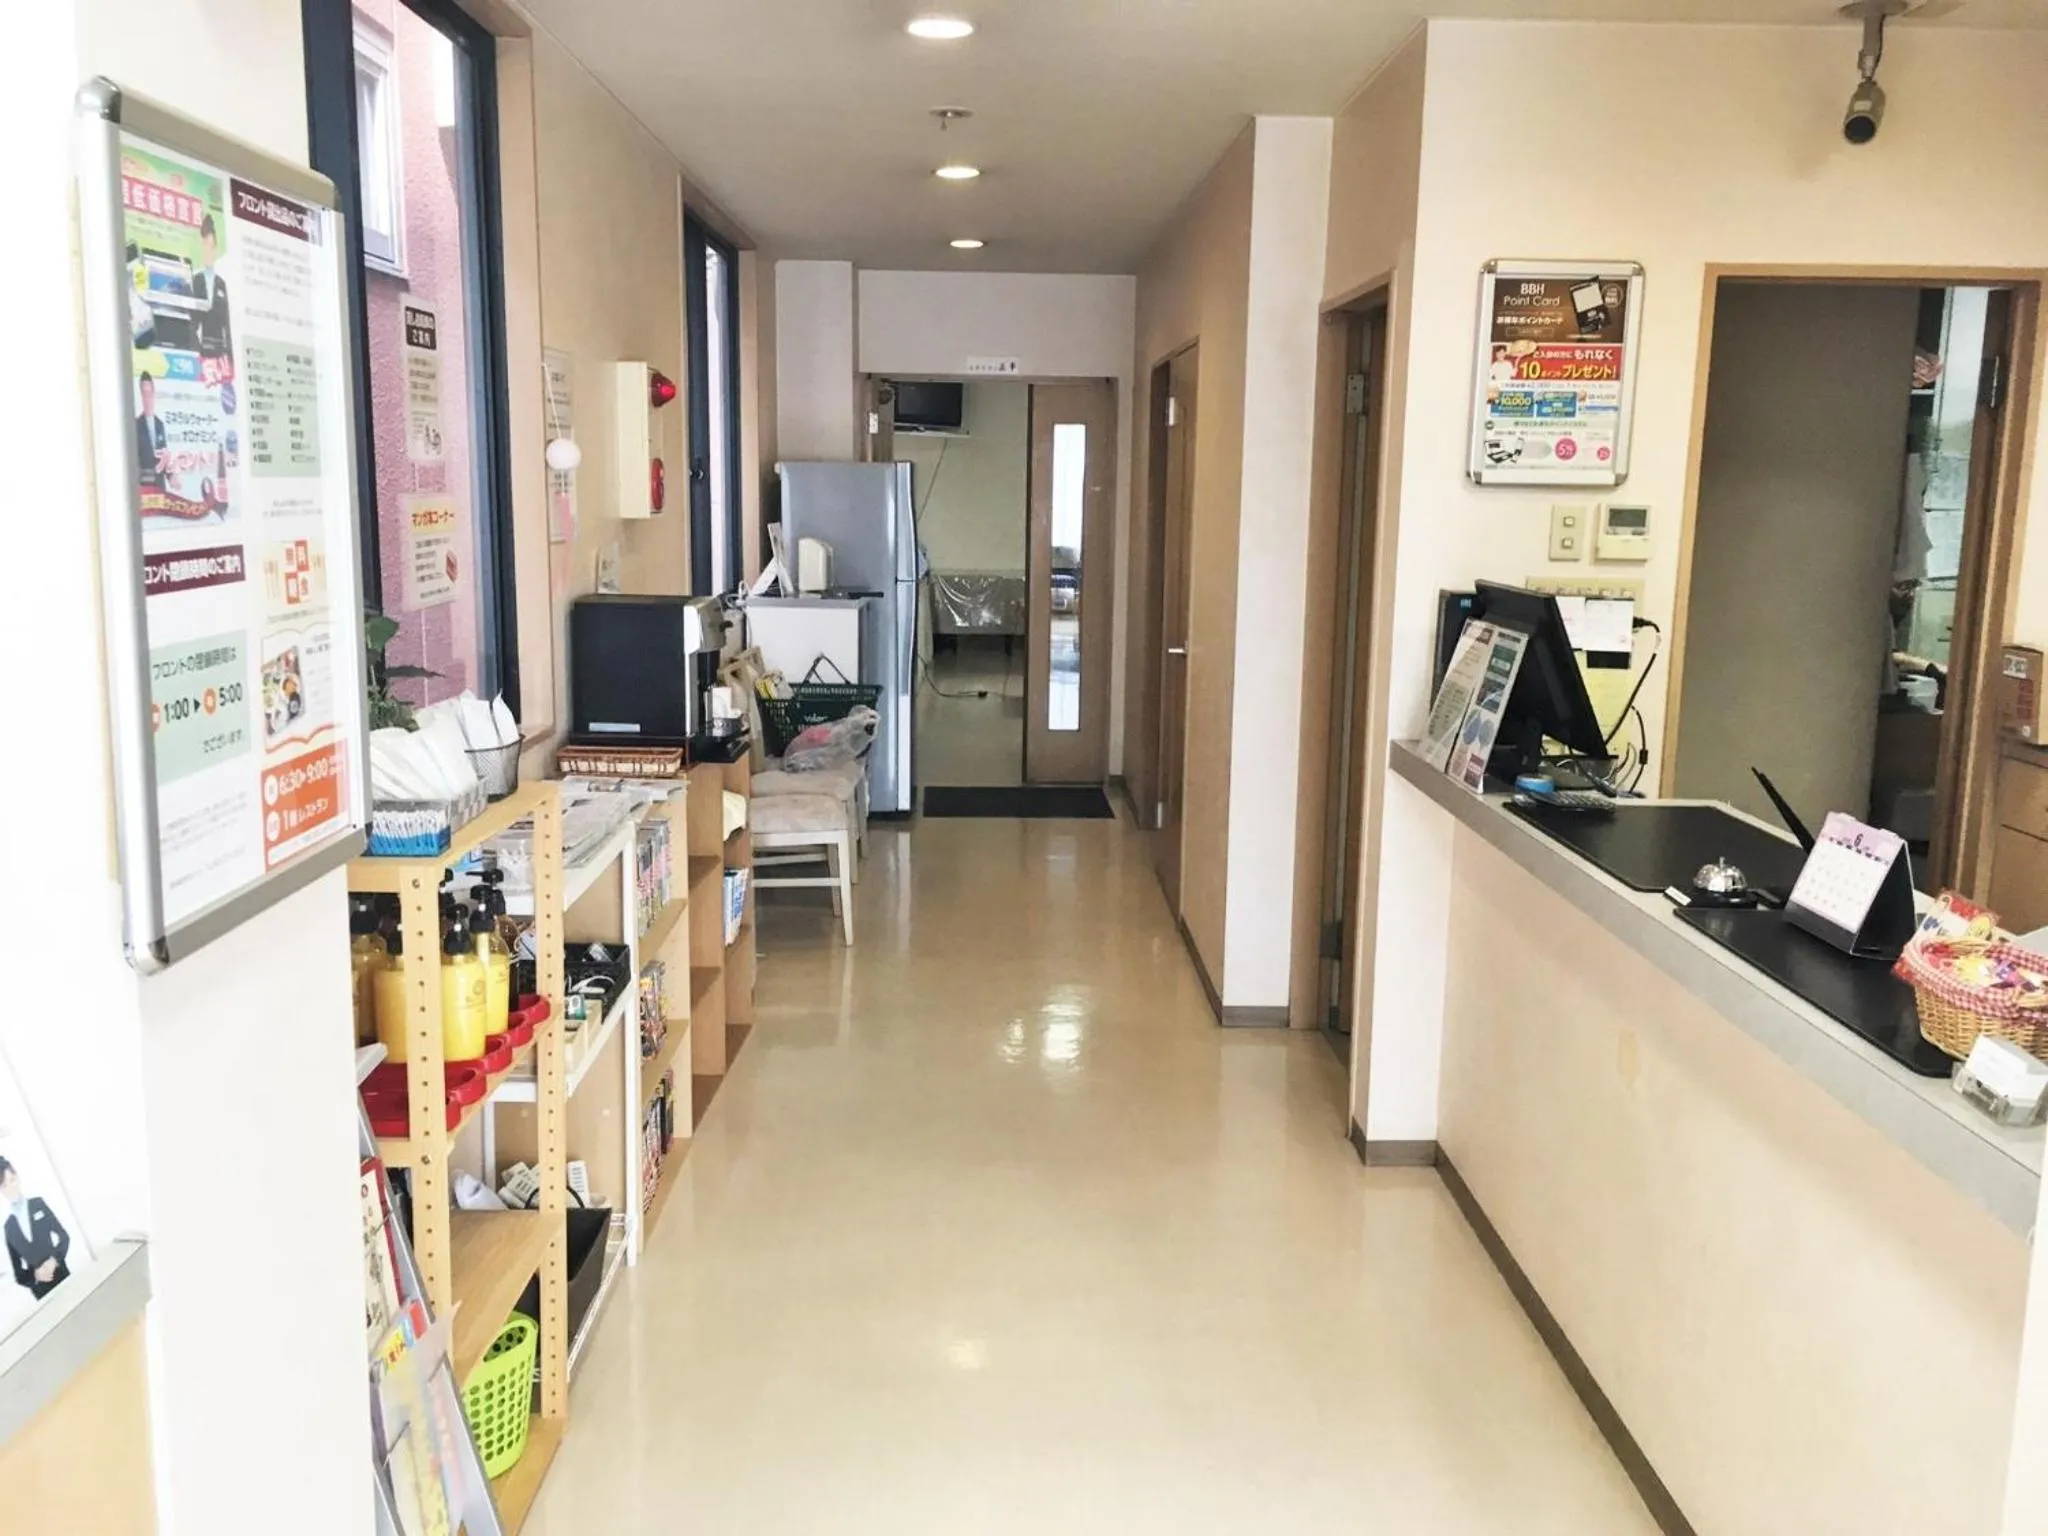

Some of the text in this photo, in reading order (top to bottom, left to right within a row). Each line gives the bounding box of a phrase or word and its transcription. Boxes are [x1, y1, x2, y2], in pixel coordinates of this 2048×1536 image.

[1521, 283, 1545, 295] BBH
[1504, 295, 1560, 306] Point Card
[164, 682, 243, 724] 1:00 5:00
[1853, 832, 1864, 847] 6
